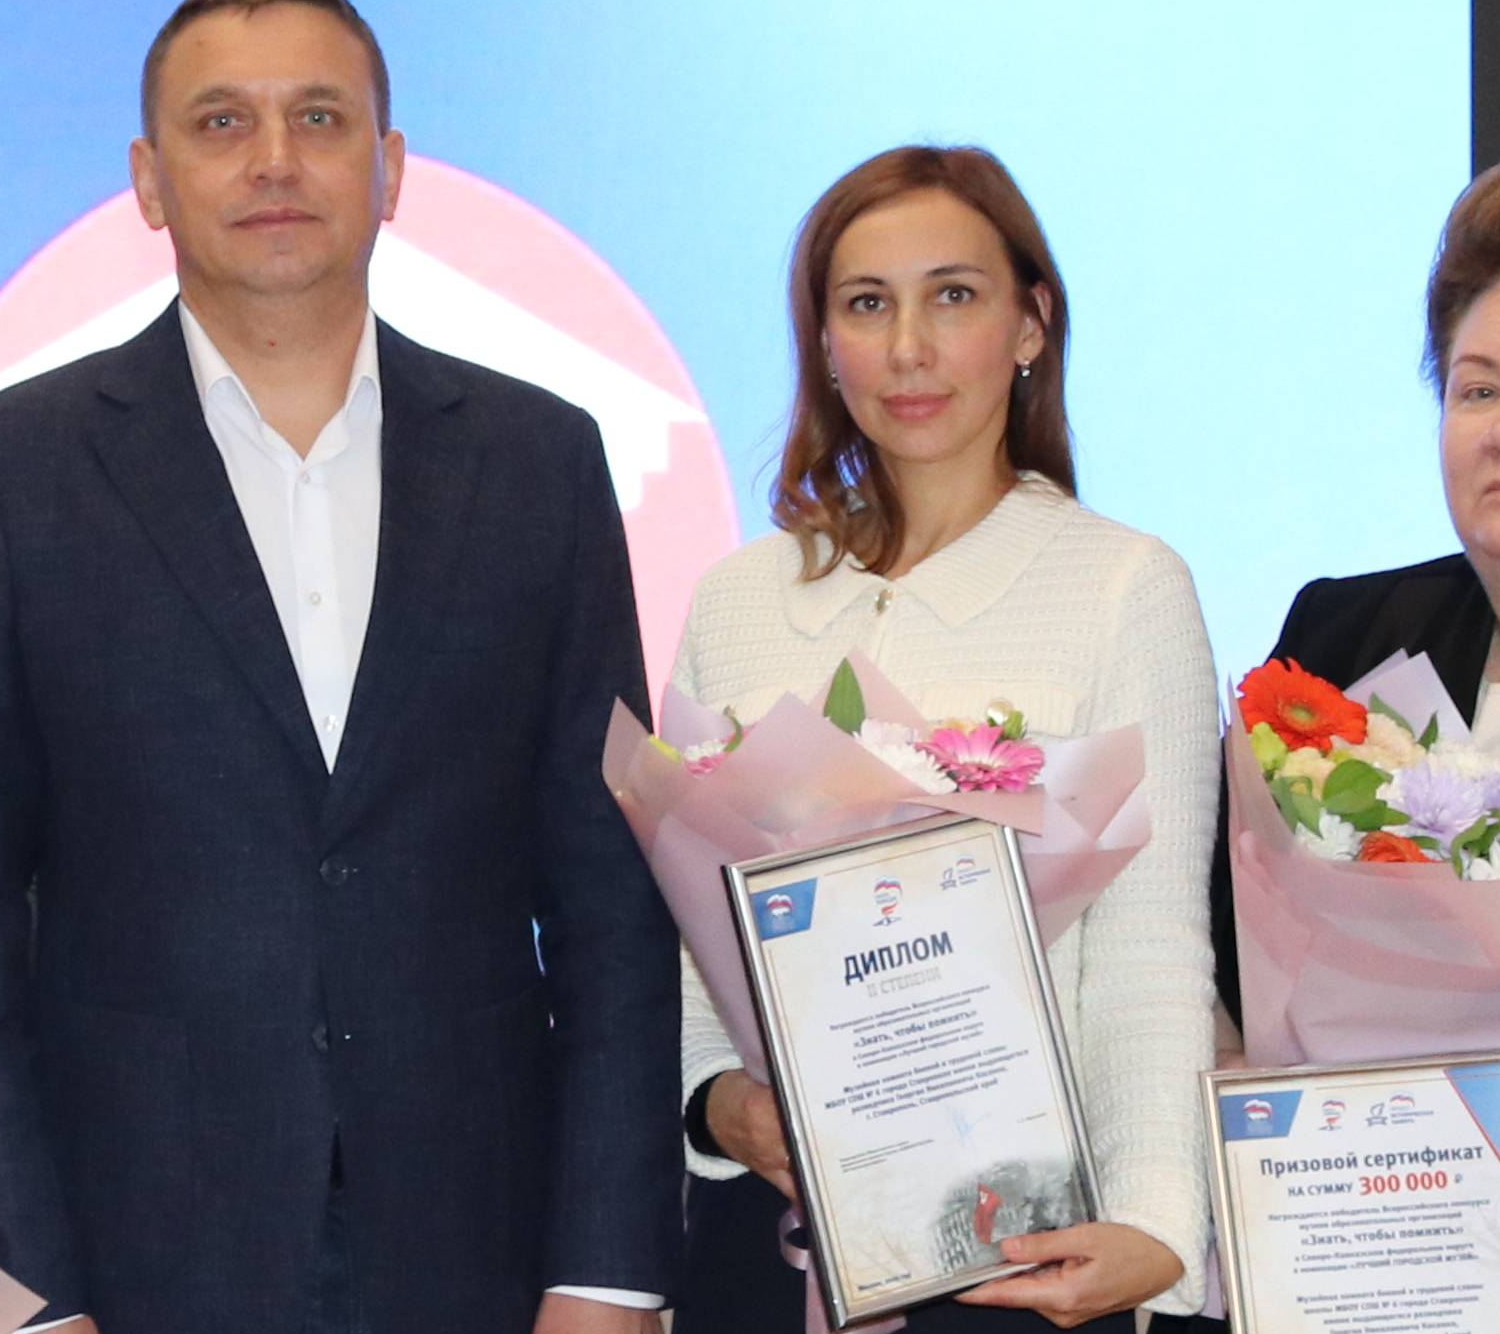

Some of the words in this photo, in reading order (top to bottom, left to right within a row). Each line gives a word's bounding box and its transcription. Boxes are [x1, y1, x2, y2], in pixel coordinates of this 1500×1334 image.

[844, 931, 953, 986] ДИПЛОМ
[1259, 1152, 1359, 1178] Призовой
[1363, 1144, 1484, 1171] сертификат
[1287, 1185, 1305, 1198] НА
[1307, 1181, 1353, 1196] СУММУ
[1358, 1174, 1401, 1196] 300
[1404, 1170, 1448, 1191] 000
[1353, 1228, 1397, 1243] чтобы
